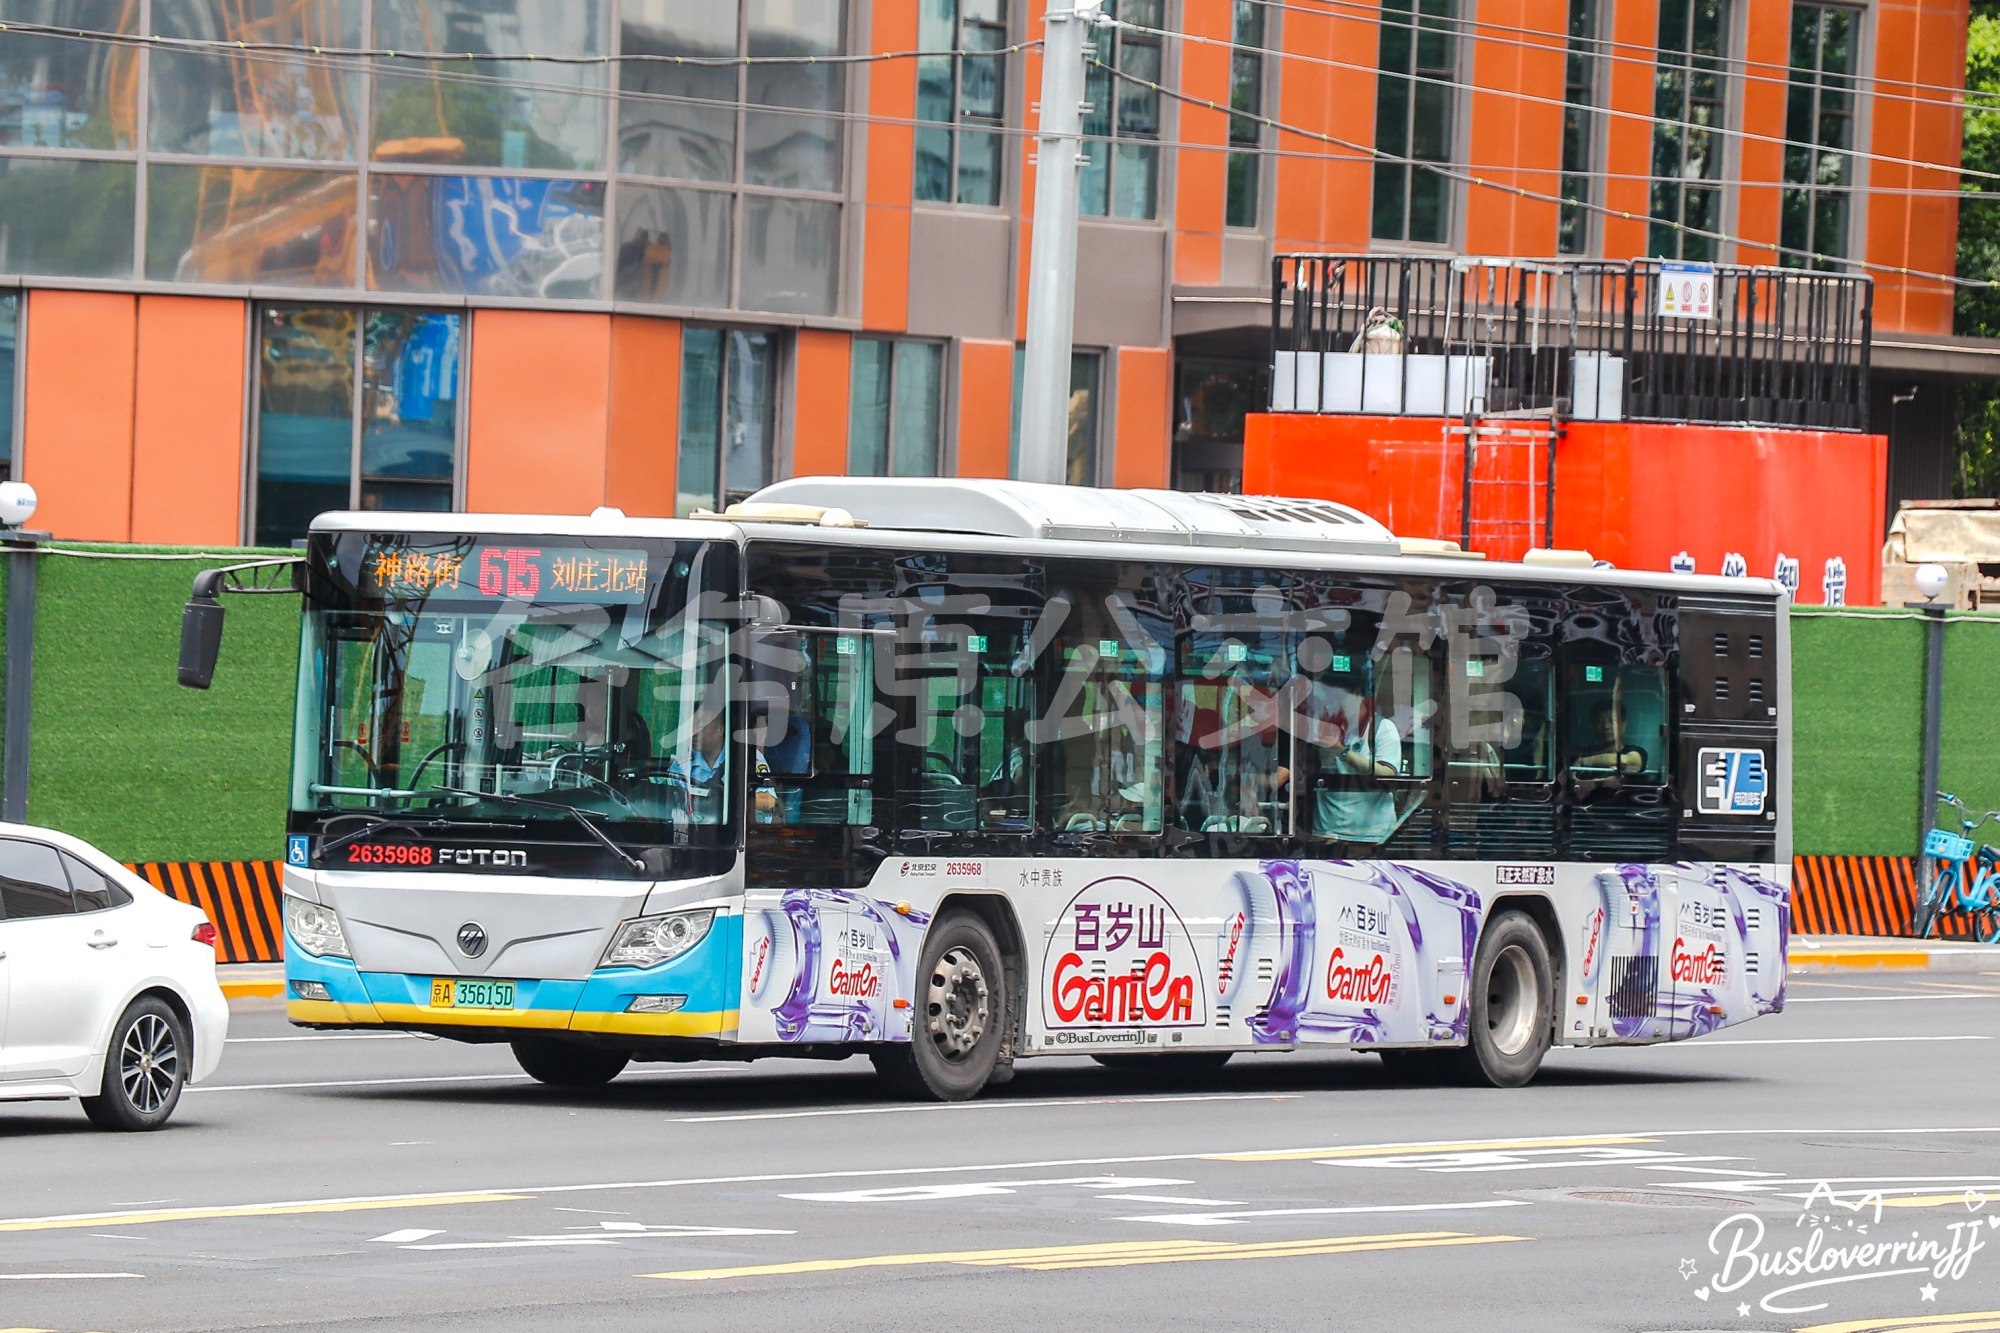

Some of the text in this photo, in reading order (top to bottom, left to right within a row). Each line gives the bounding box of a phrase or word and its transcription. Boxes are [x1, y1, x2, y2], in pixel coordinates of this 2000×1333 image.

[374, 551, 462, 589] 神路街
[478, 548, 541, 596] 615
[551, 556, 648, 594] 刘庄北站
[349, 844, 527, 866] 2635968 FOTON
[946, 863, 982, 875] 2635968
[1019, 869, 1063, 887] 水中贵族
[1497, 867, 1553, 883] 真正天然矿泉水
[1075, 902, 1164, 952] 百岁山
[1357, 904, 1388, 935] 百岁山
[851, 929, 875, 950] 百岁山
[830, 959, 877, 997] Ganten
[1052, 951, 1193, 1023] Ganten
[1327, 947, 1391, 1004] Ganten
